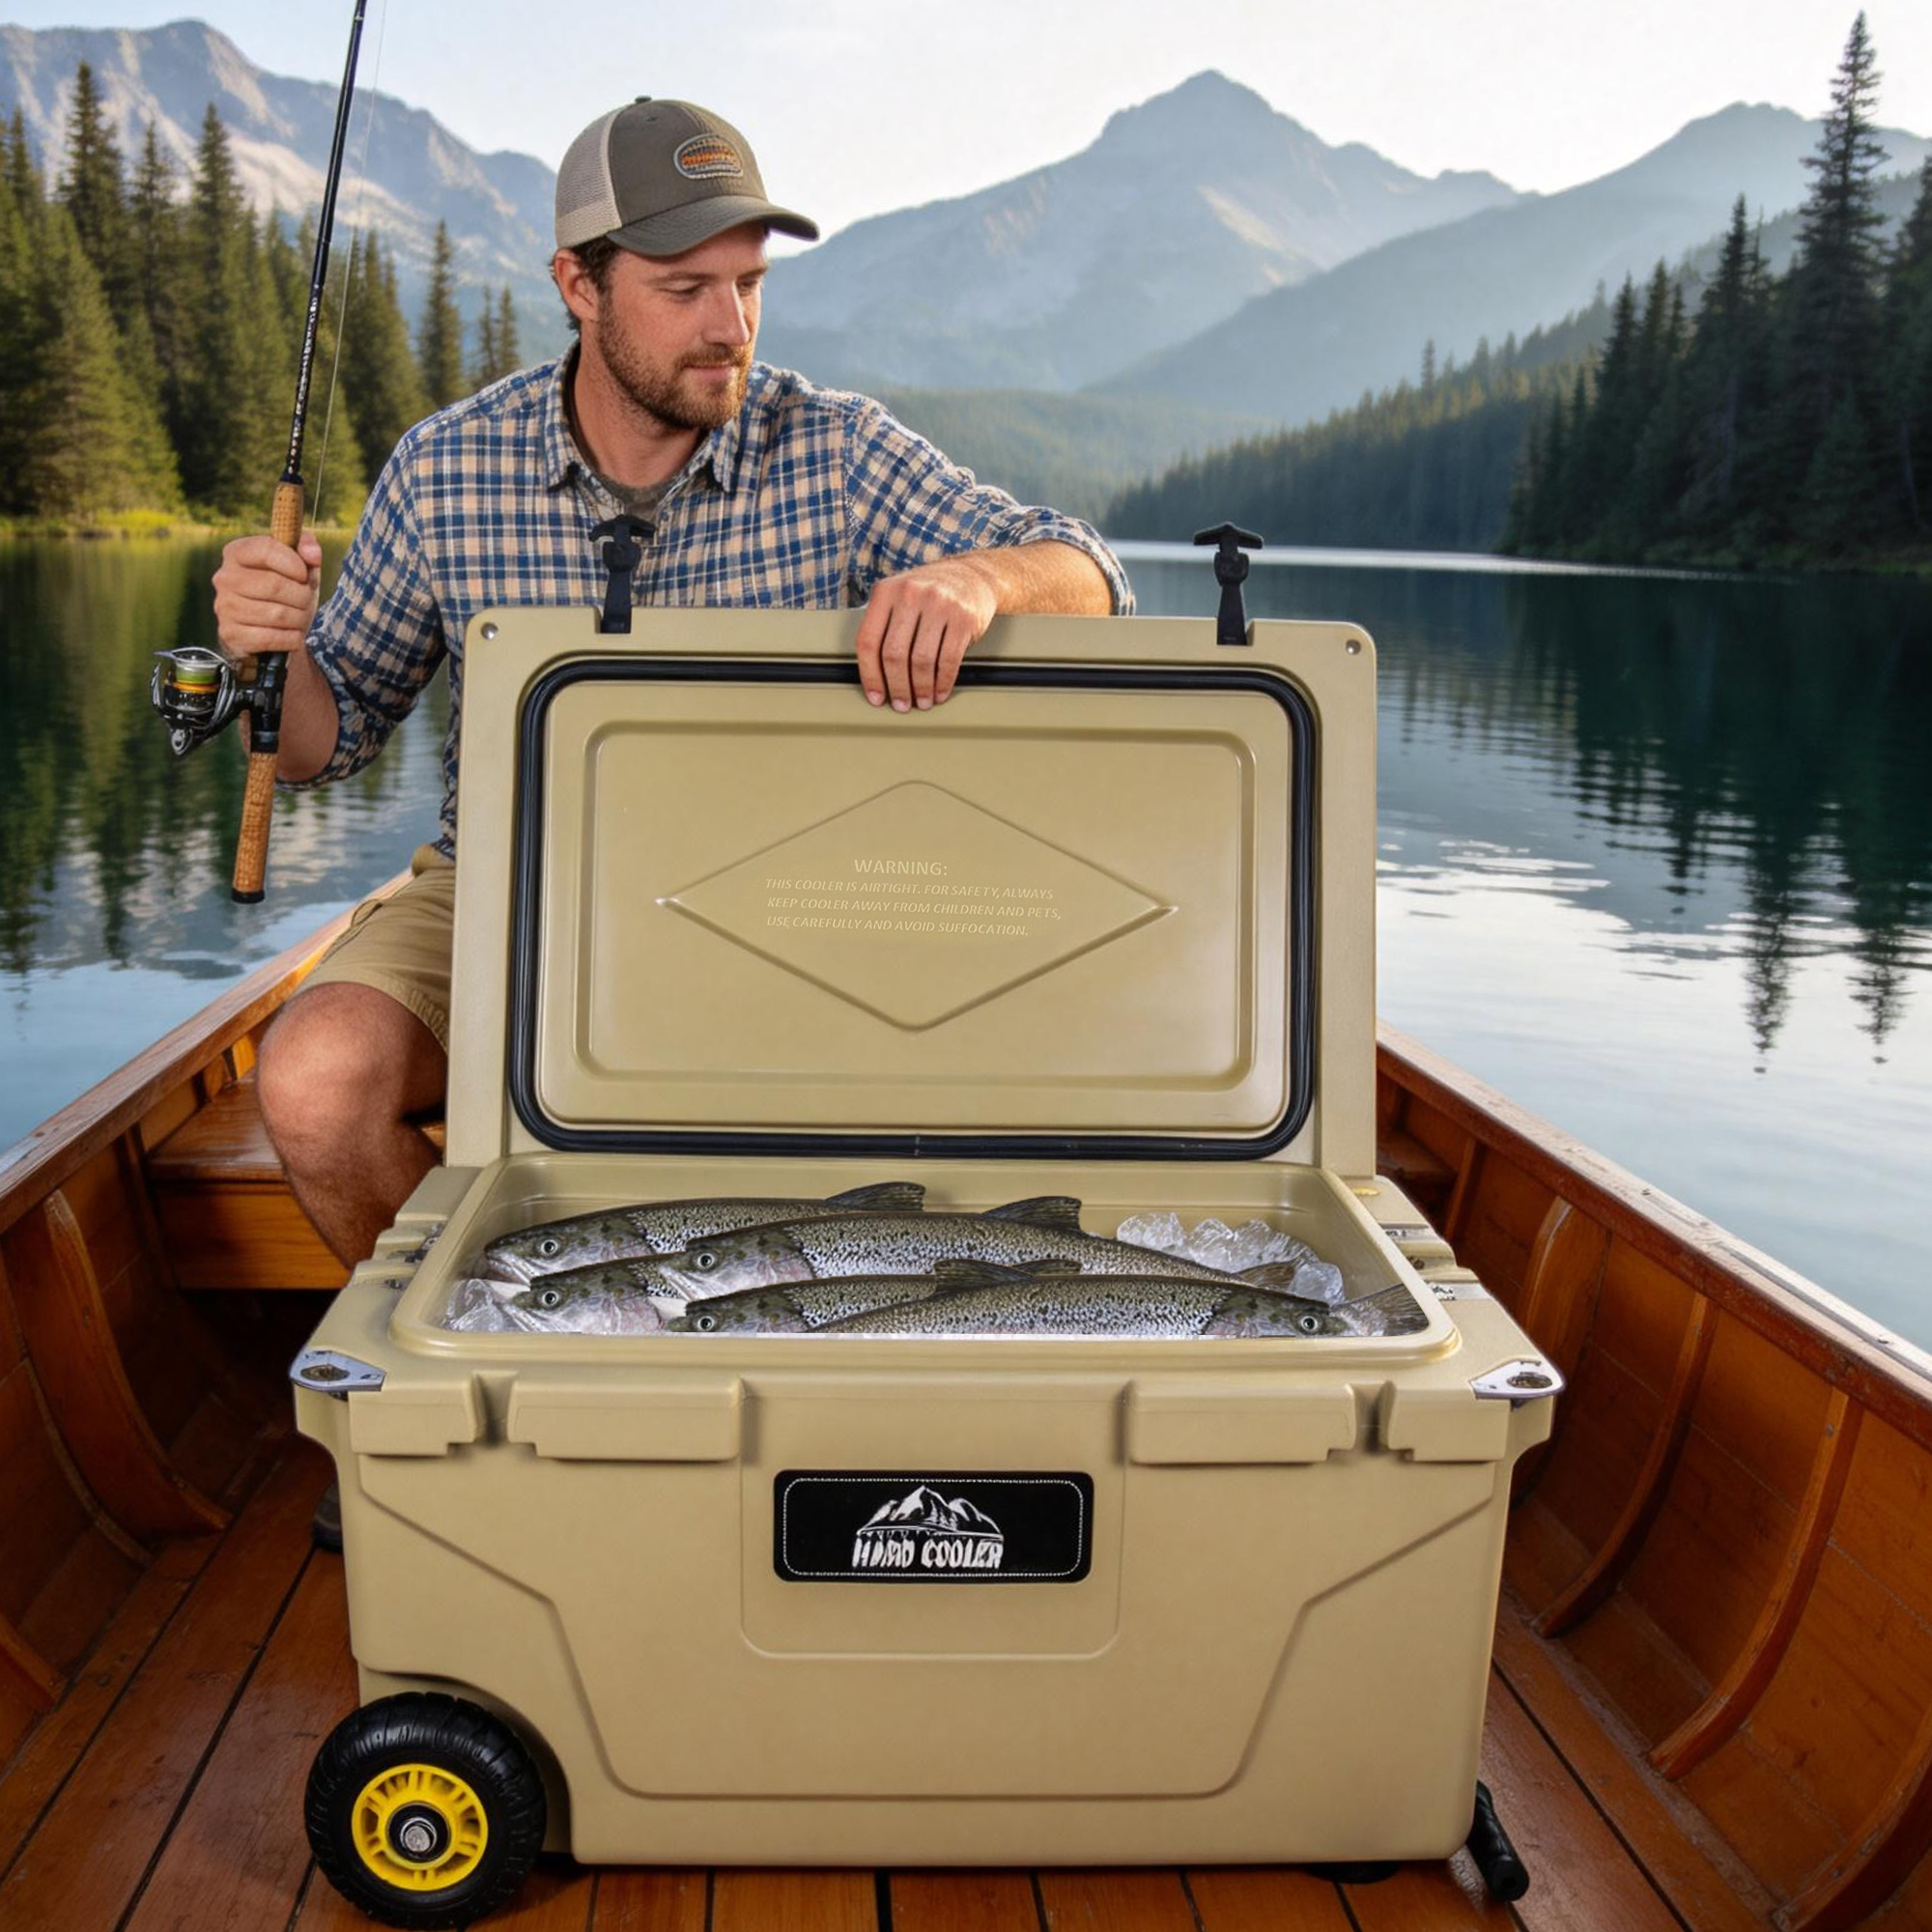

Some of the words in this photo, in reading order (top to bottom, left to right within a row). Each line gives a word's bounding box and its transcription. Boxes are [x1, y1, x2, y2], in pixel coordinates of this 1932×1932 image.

[854, 859, 948, 876] WARNING:
[765, 878, 792, 890] THIS
[795, 879, 843, 892] COOLER
[846, 882, 857, 892] IS
[860, 882, 921, 895] AIRTIGHT.
[923, 884, 949, 895] FOR
[951, 885, 1000, 899] SAFETY,
[1002, 888, 1054, 899] ALWAYS
[768, 897, 798, 908] KEEP
[801, 898, 849, 910] COOLER
[852, 900, 891, 912] AWAY
[894, 902, 931, 913] FROM
[933, 904, 994, 916] CHILDREN
[997, 906, 1024, 917] AND
[1027, 907, 1061, 921] PETS,
[793, 917, 863, 929] CAREFULLY
[864, 920, 893, 930] AND
[895, 921, 935, 932] AVOID
[938, 923, 1029, 936] SUFFOCATION.
[922, 1539, 1004, 1568] COOLER
